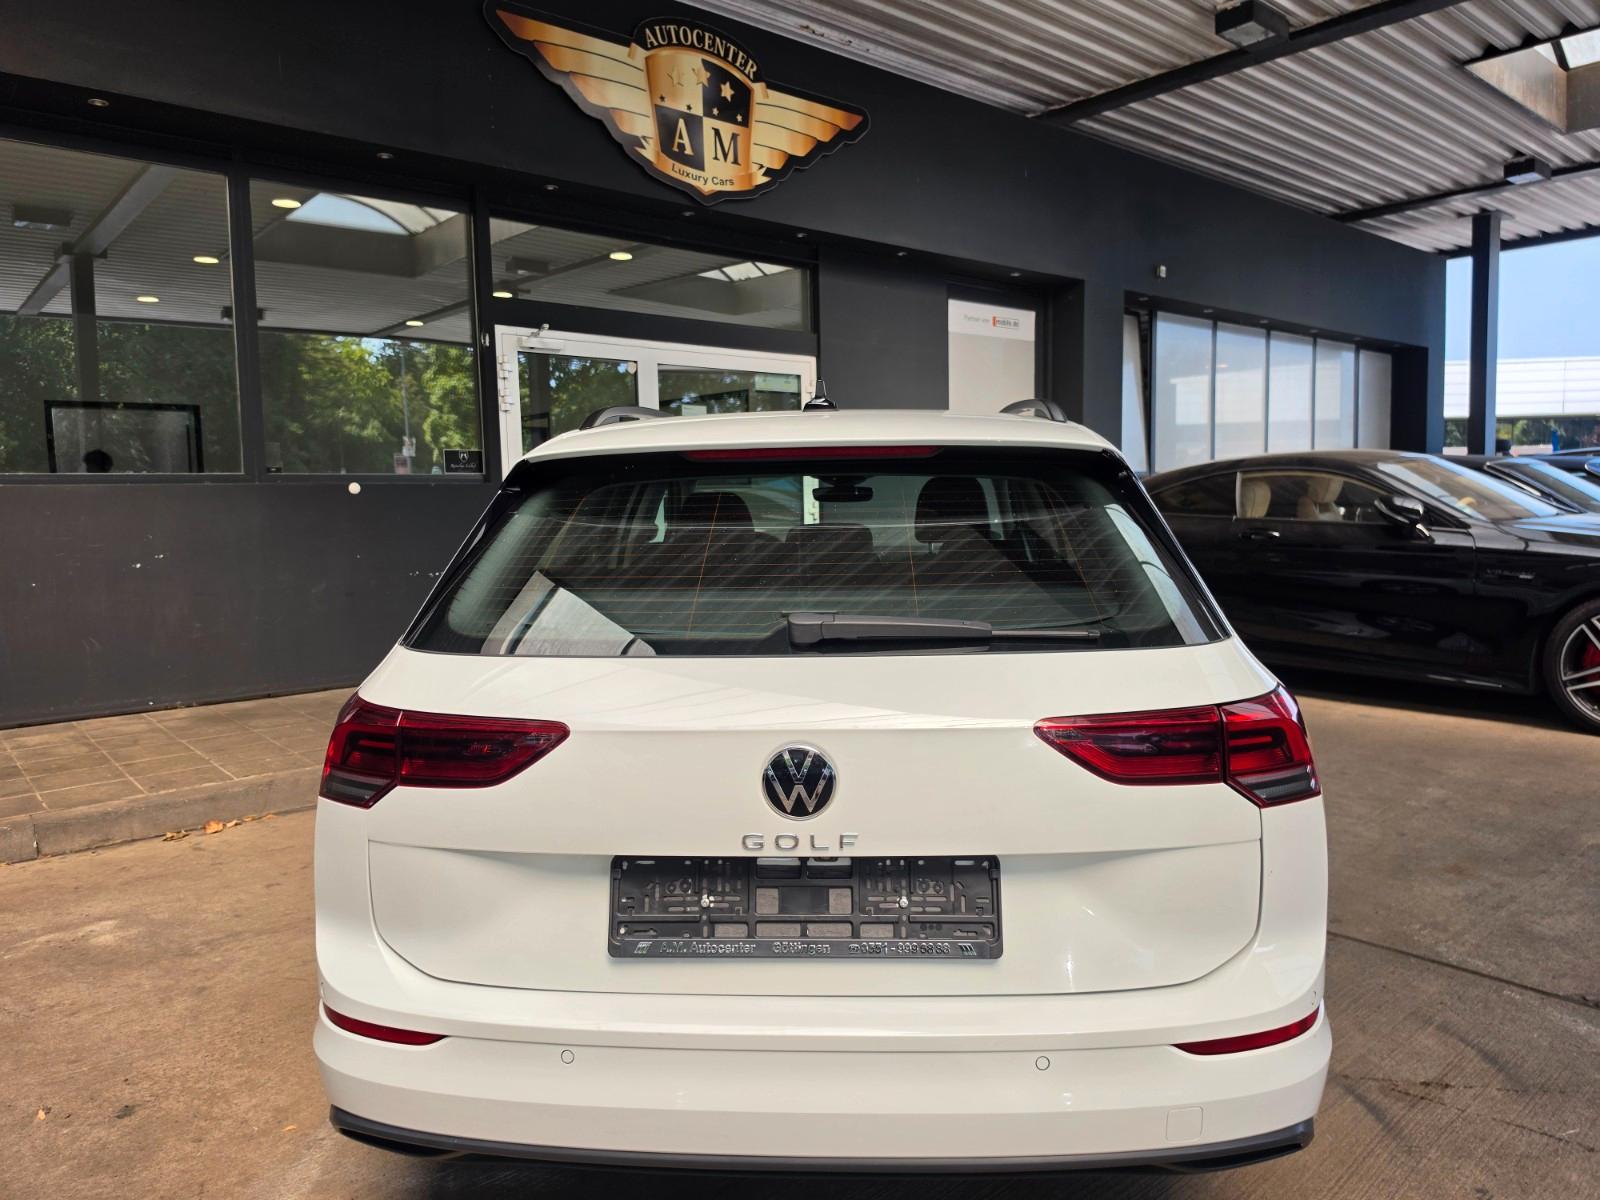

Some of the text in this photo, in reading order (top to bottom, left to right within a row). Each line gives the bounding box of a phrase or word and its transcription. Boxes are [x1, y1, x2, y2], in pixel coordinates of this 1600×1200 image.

[645, 25, 758, 80] AUTOCENTER
[672, 117, 742, 167] A M
[671, 164, 735, 186] Luxury Cars
[742, 832, 859, 851] GOLF
[690, 941, 756, 954] Autocenter
[772, 941, 831, 955] Göttingen
